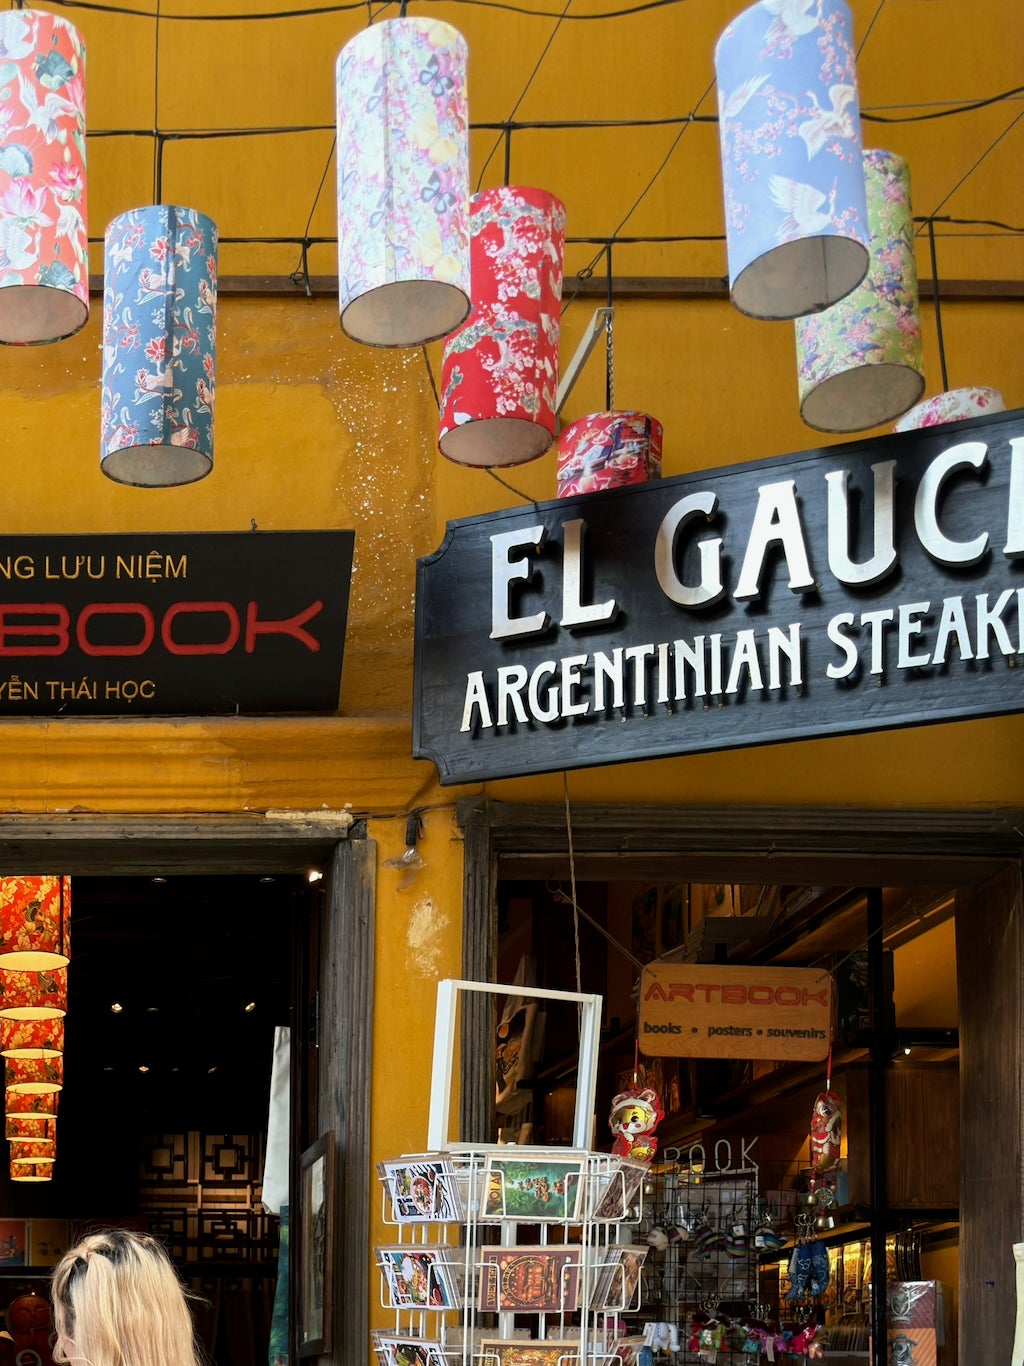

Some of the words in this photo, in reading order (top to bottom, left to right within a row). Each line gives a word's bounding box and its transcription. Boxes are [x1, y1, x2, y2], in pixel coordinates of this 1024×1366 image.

[45, 555, 106, 580] LƯU
[115, 550, 188, 583] NIỆM
[488, 518, 618, 641] EL
[45, 676, 98, 701] THÁI
[104, 680, 157, 703] HỌC
[459, 622, 803, 733] ARGENTINIAN
[644, 982, 829, 1007] ARTBOOK
[643, 1022, 682, 1035] books
[707, 1025, 753, 1038] posters
[766, 1027, 826, 1040] souvenirs
